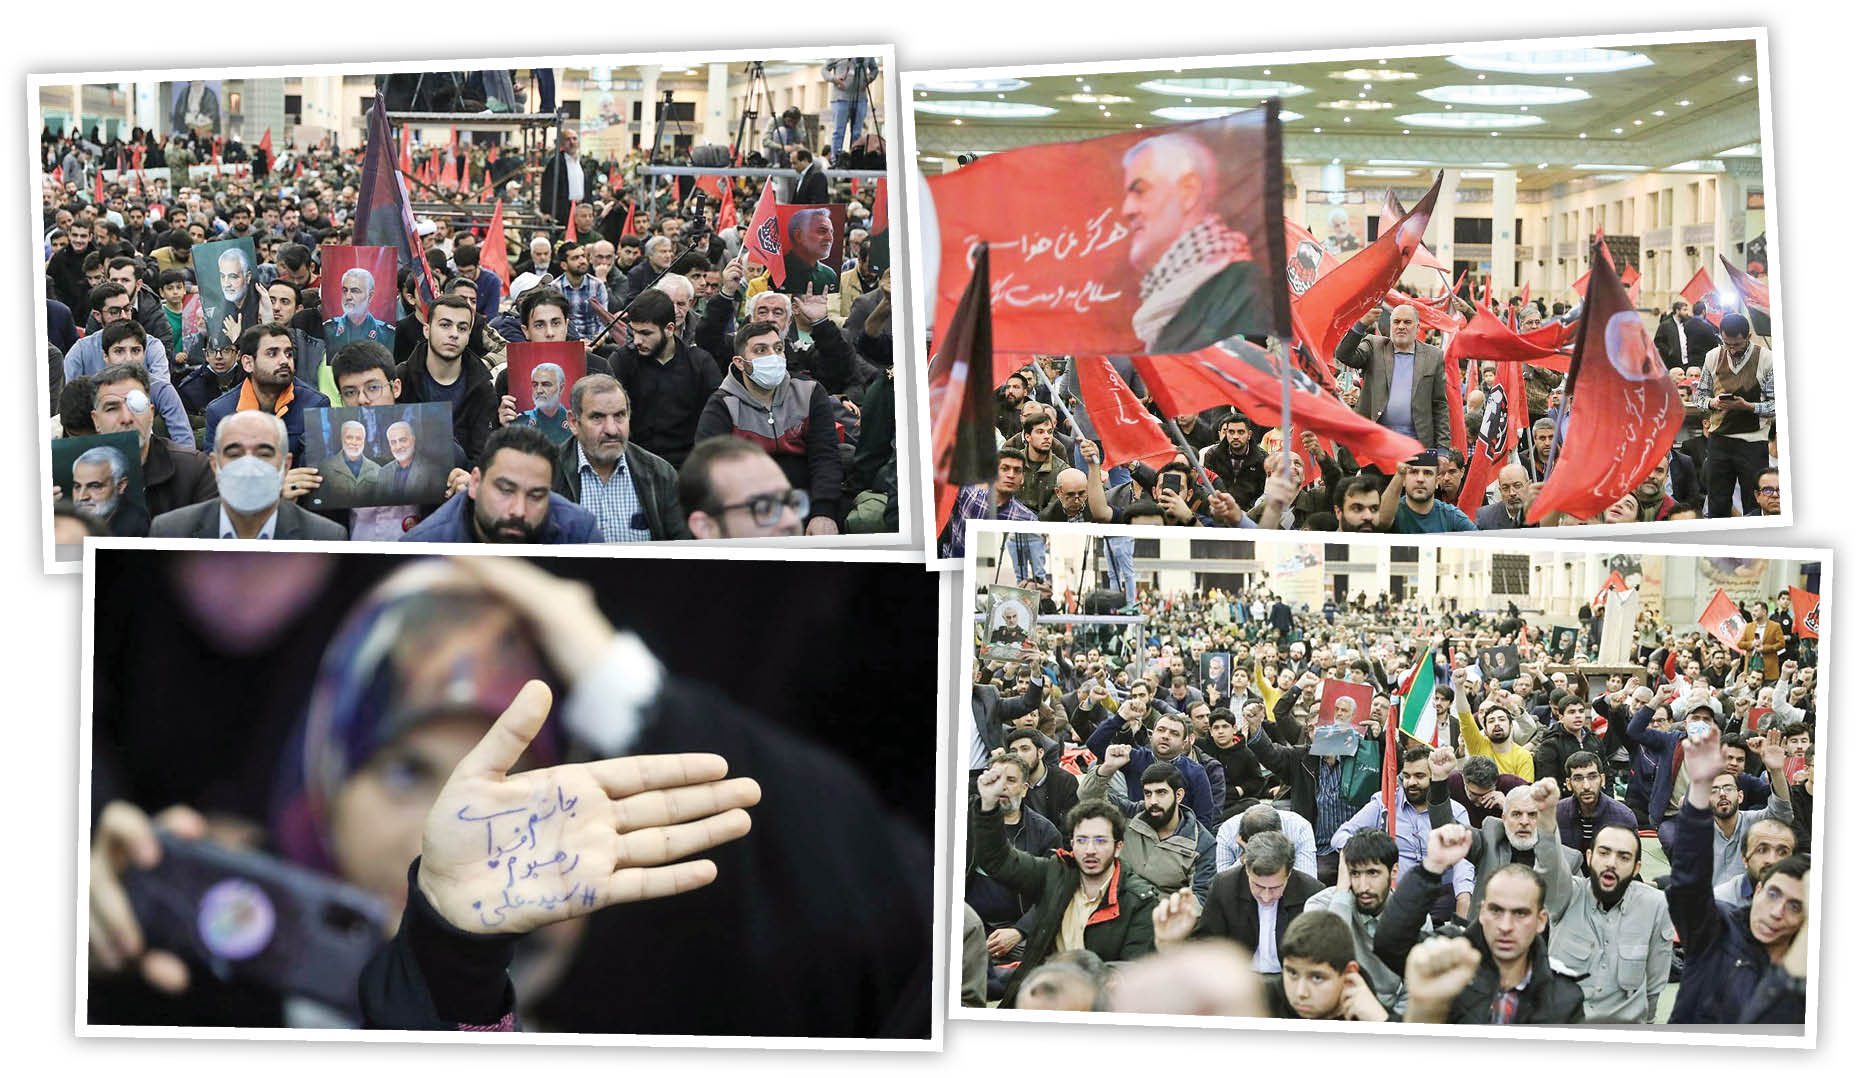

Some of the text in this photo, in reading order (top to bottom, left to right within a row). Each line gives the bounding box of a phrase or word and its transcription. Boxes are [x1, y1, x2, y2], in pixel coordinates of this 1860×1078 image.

[1073, 279, 1122, 313] سلاح
[528, 785, 578, 850] جانم
[505, 850, 579, 889] رهبرم
